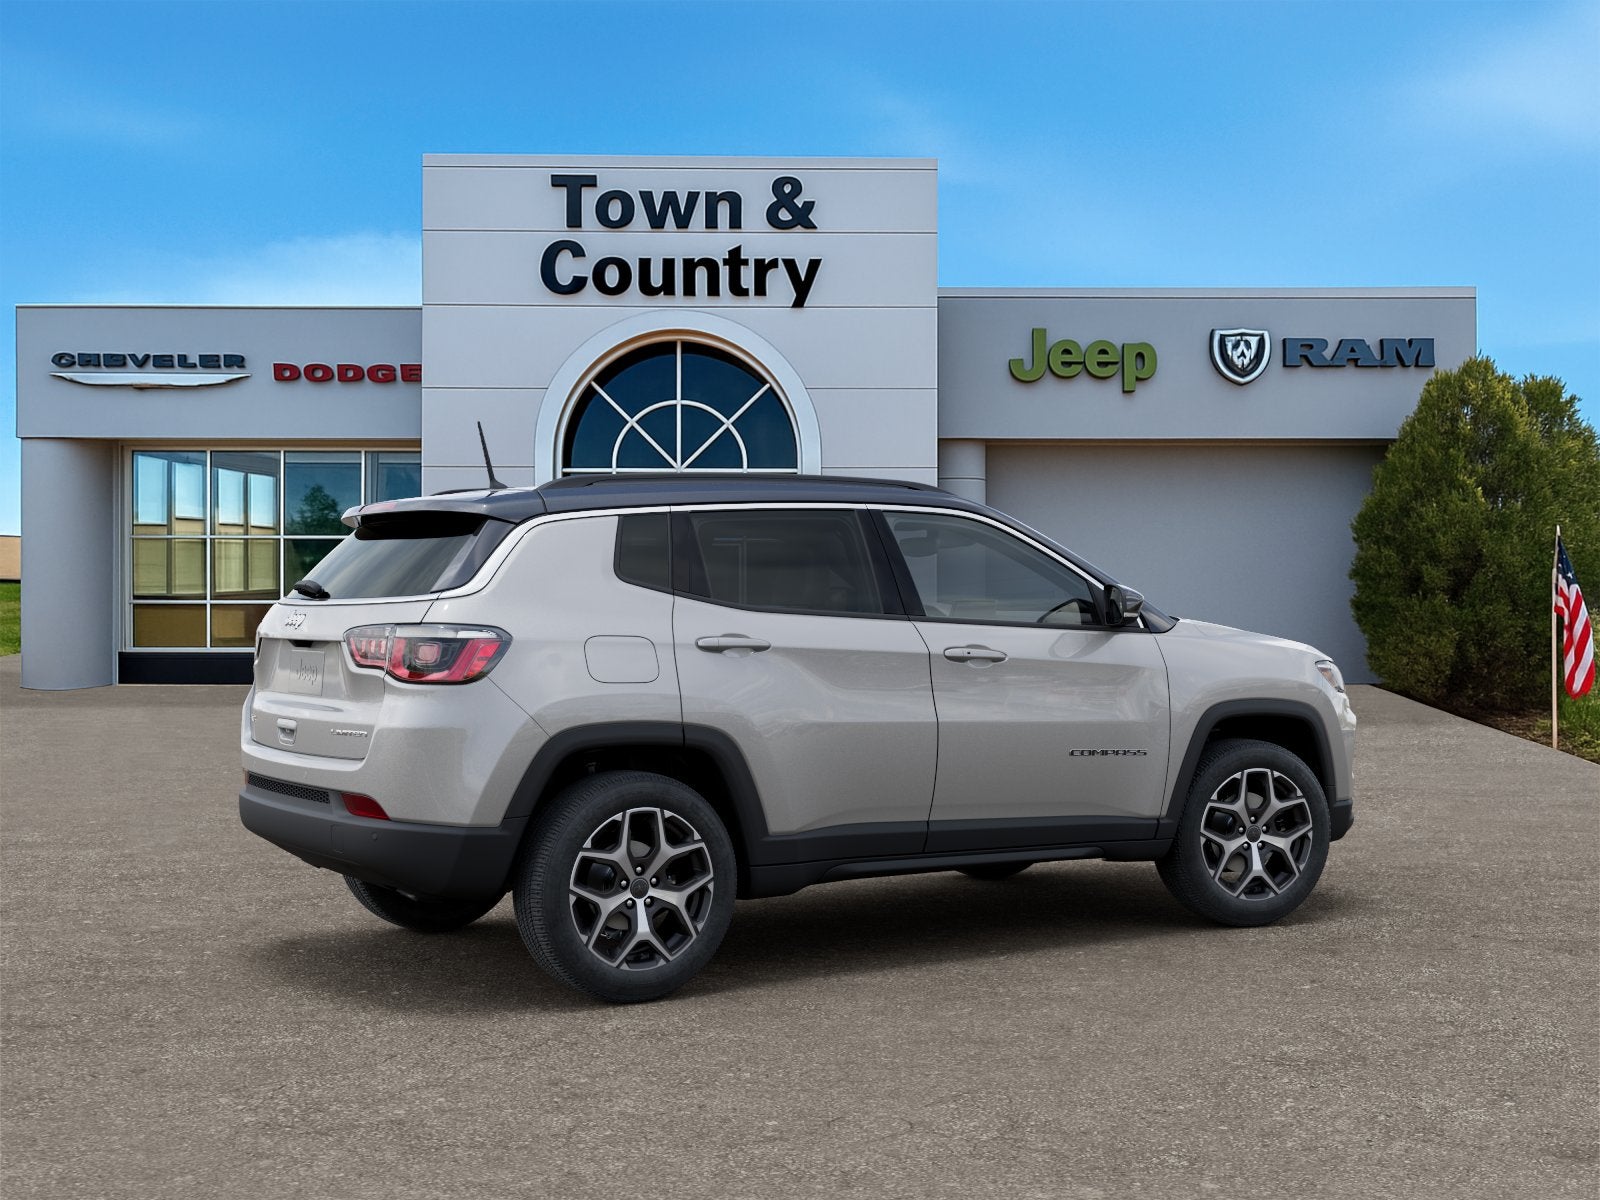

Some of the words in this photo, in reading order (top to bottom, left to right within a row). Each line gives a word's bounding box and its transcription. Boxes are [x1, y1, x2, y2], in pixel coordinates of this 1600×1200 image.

[550, 174, 742, 229] Town
[765, 176, 818, 230] &
[540, 239, 822, 308] Country
[273, 362, 422, 383] DODGE
[1008, 327, 1158, 392] Jeep
[1282, 337, 1436, 368] RAM
[1069, 748, 1148, 757] COMPASS
